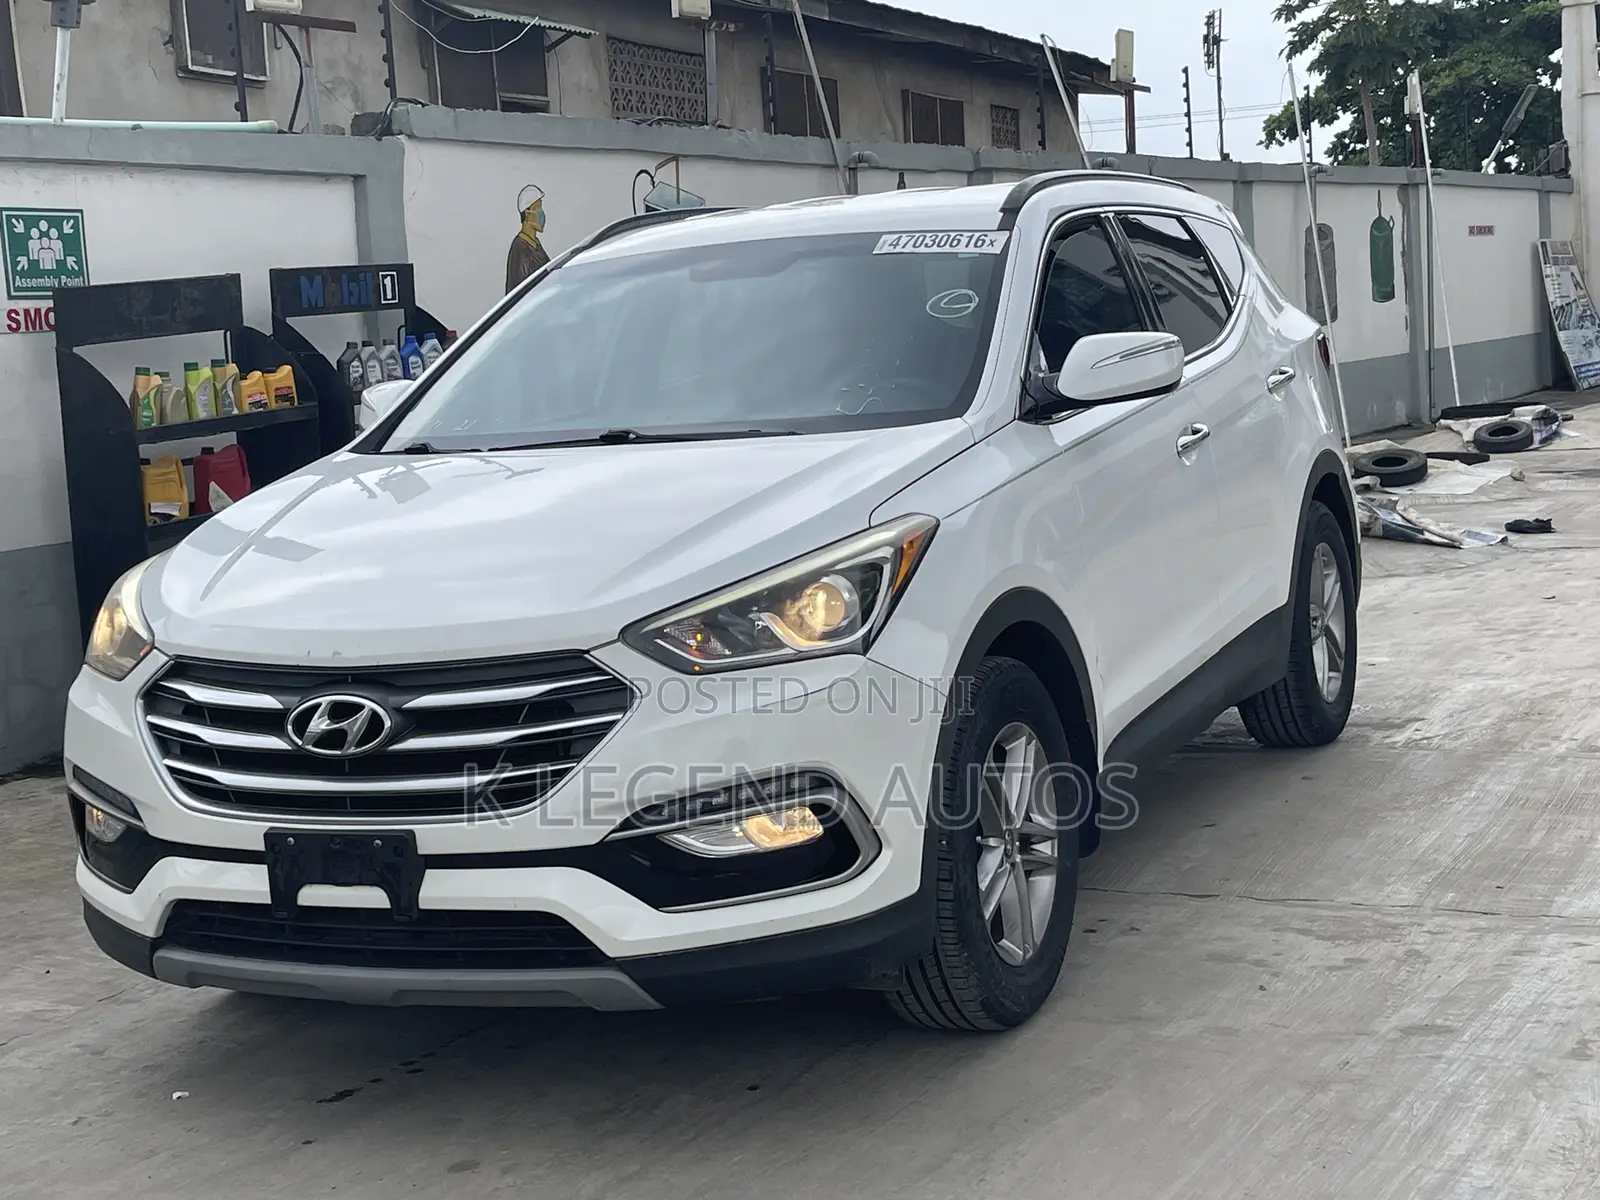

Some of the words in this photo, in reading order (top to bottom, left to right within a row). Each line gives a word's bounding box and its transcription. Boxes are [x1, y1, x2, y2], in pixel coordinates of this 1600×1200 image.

[15, 275, 58, 288] Assembly
[61, 275, 84, 287] Point
[301, 272, 372, 308] Mbil
